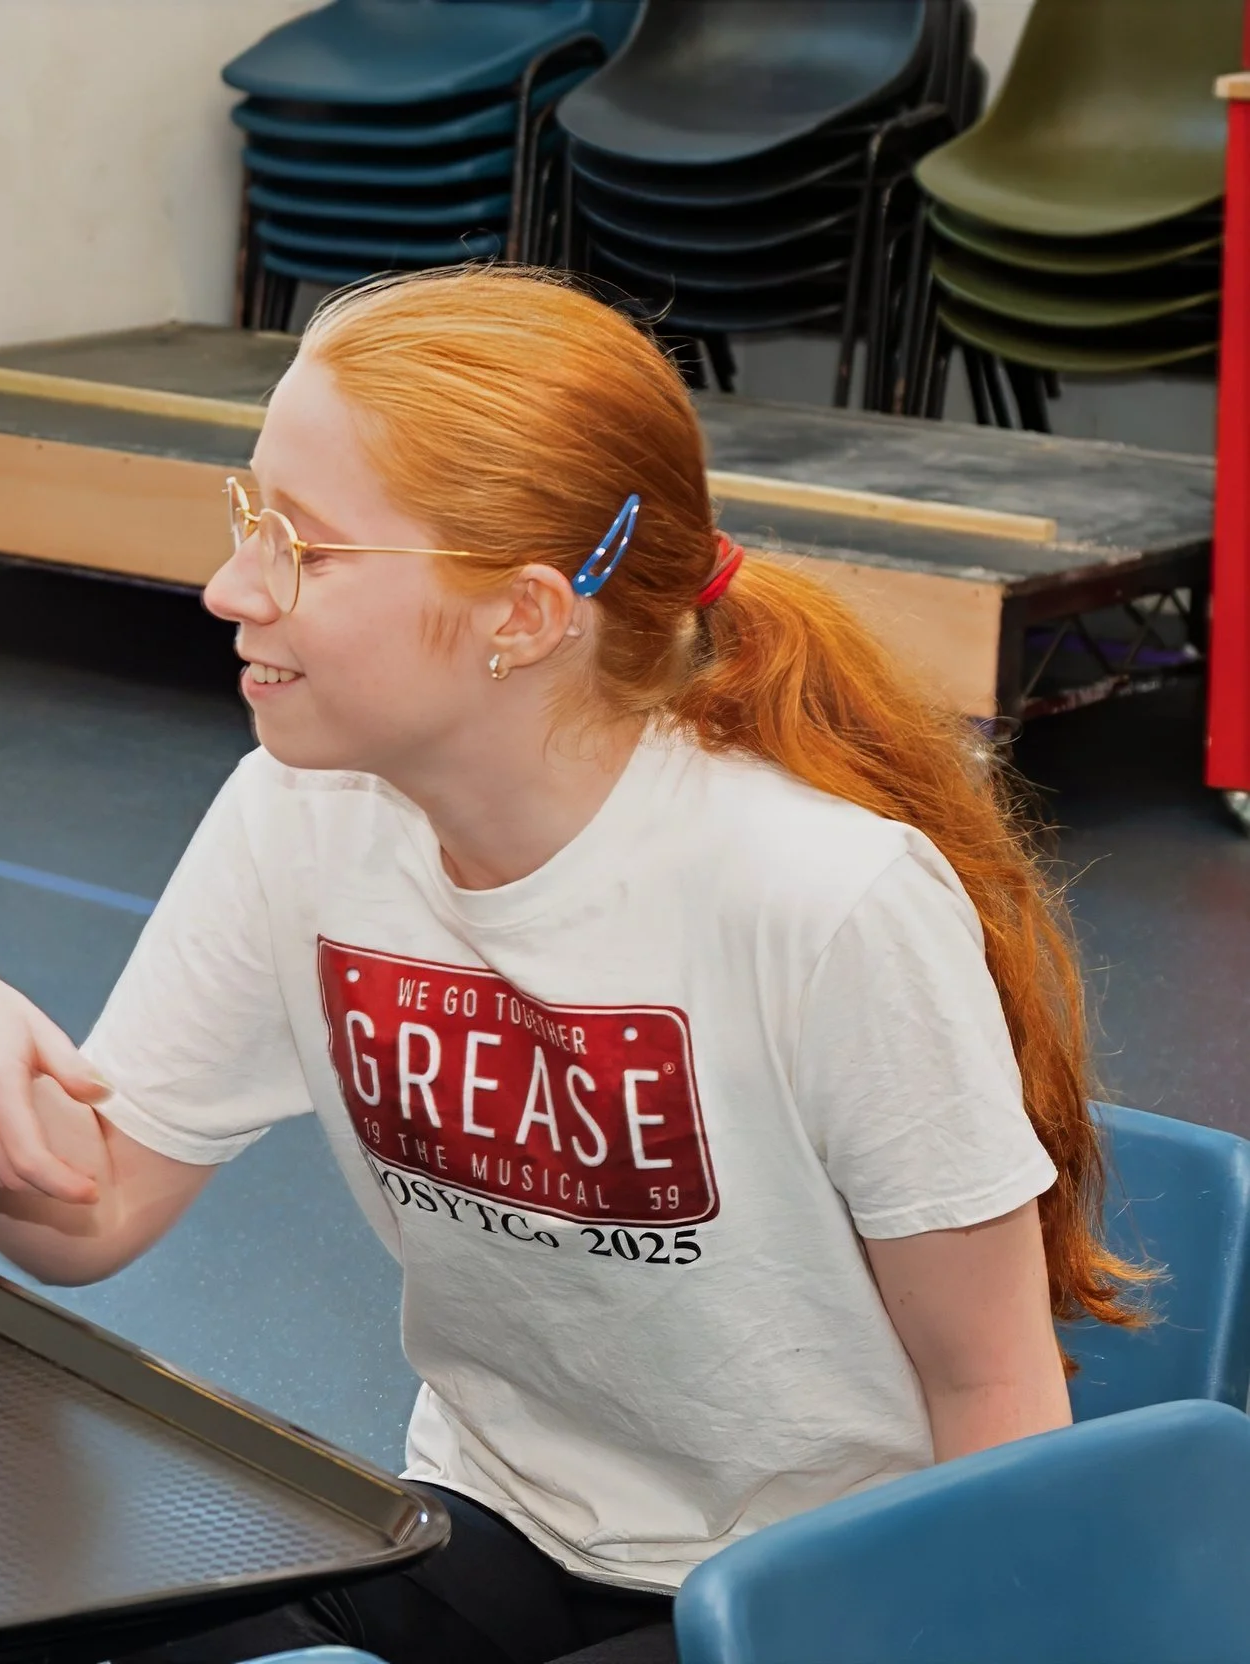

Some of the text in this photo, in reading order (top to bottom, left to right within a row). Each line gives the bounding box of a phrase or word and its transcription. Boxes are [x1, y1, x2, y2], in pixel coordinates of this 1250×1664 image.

[397, 977, 588, 1056] WE GO TOGETHER
[345, 1010, 673, 1170] GREASE
[363, 1116, 680, 1211] 19 THE MUSICAL 59
[368, 1158, 703, 1266] OSYTCo 2025
